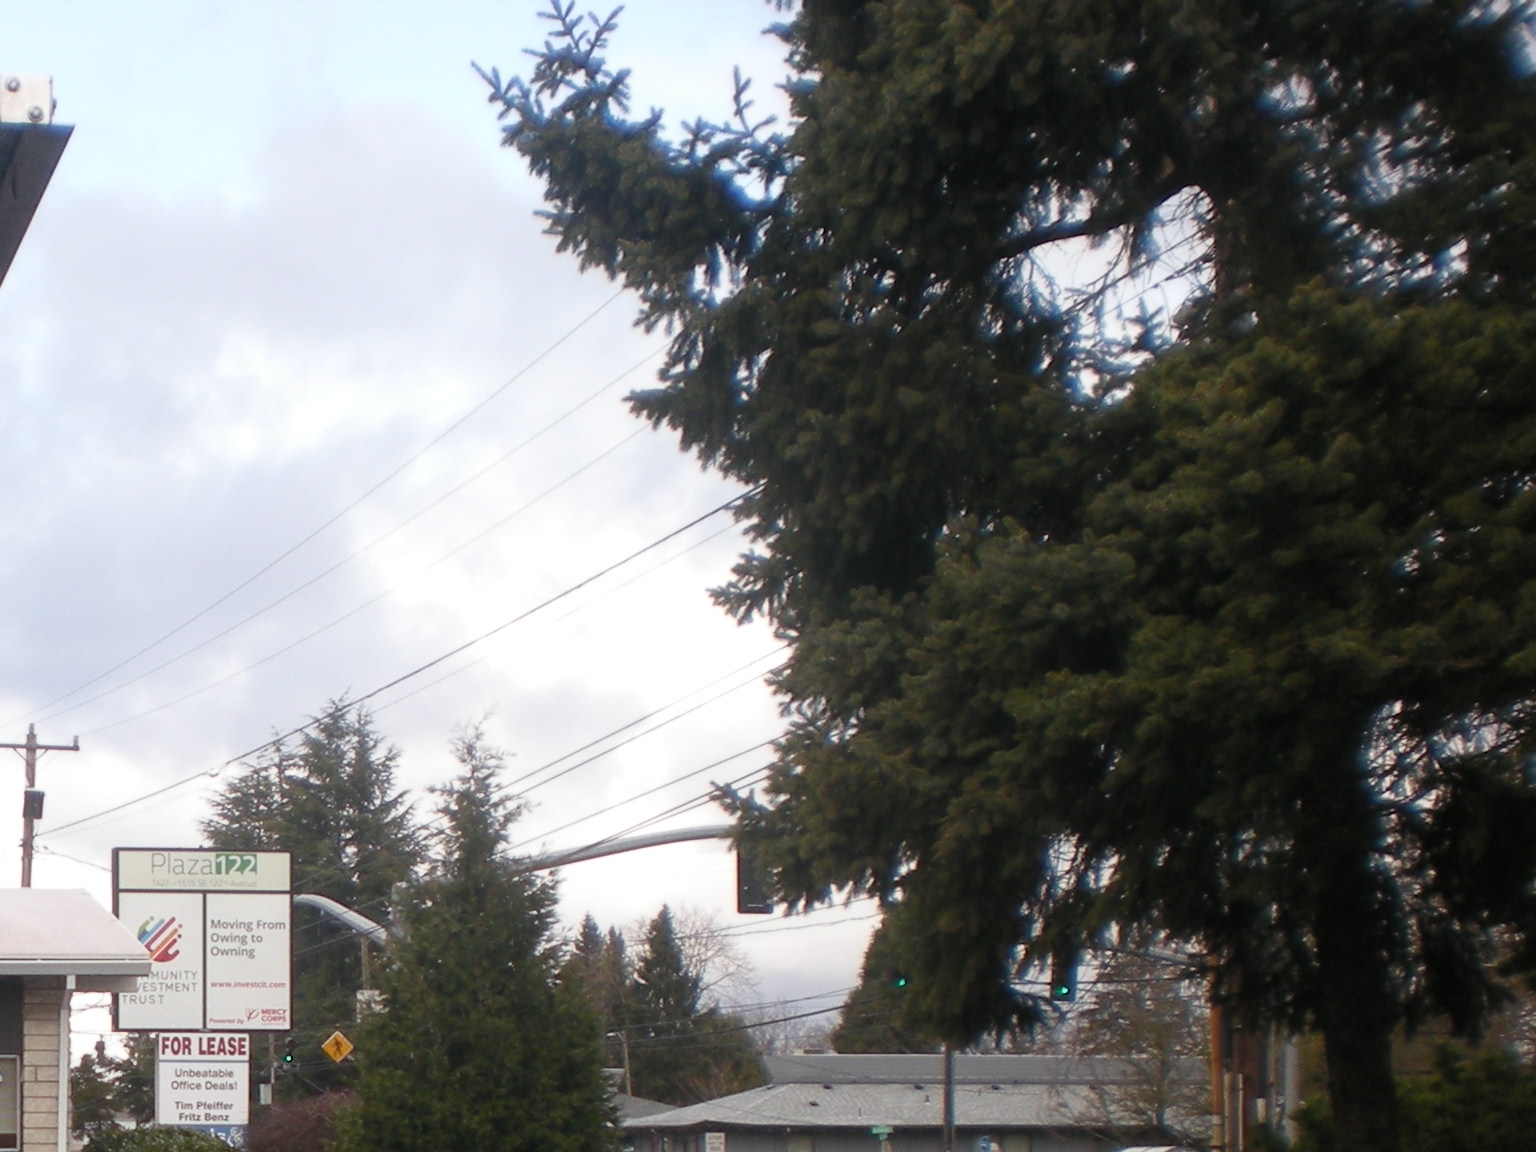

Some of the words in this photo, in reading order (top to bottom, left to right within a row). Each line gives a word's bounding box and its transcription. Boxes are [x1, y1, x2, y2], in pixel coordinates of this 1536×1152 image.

[151, 852, 214, 875] Plaza
[216, 854, 257, 875] 122
[211, 919, 253, 932] Moving
[256, 920, 286, 930] From
[211, 932, 248, 945] Owing
[251, 934, 263, 943] to
[211, 946, 256, 959] Owning
[148, 970, 198, 980] MUNITY
[210, 980, 286, 988] www.investcit.com
[121, 994, 165, 1004] TRUST
[161, 1036, 192, 1055] FOR
[198, 1037, 247, 1056] LEASE
[175, 1068, 234, 1078] Unbeatable
[171, 1081, 202, 1090] Office
[205, 1081, 238, 1090] Deals!
[175, 1101, 193, 1110] Tim
[196, 1101, 234, 1110] Pfeiffer
[179, 1112, 201, 1121] Fritz
[204, 1112, 230, 1121] Benz
